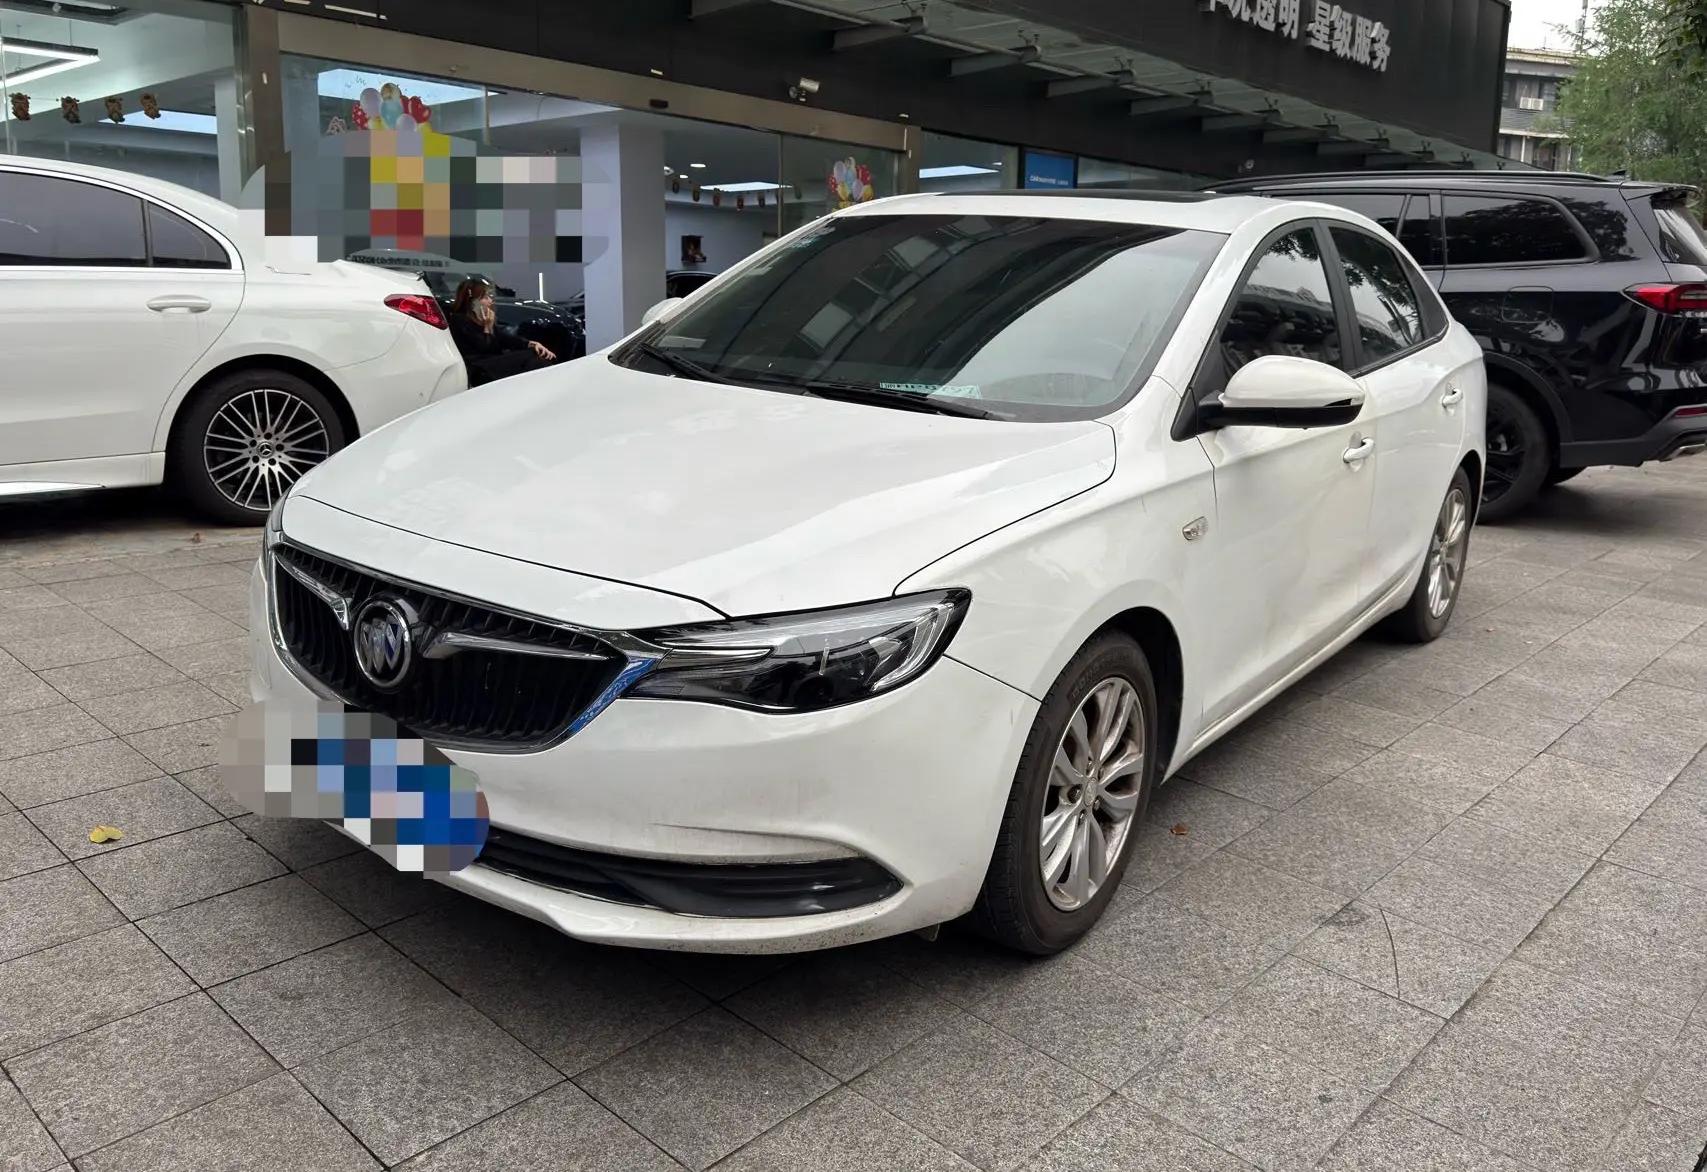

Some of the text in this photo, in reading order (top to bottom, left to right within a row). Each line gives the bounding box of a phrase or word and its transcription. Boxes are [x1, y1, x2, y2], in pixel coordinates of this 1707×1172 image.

[1202, 0, 1391, 72] 透明 星级服务
